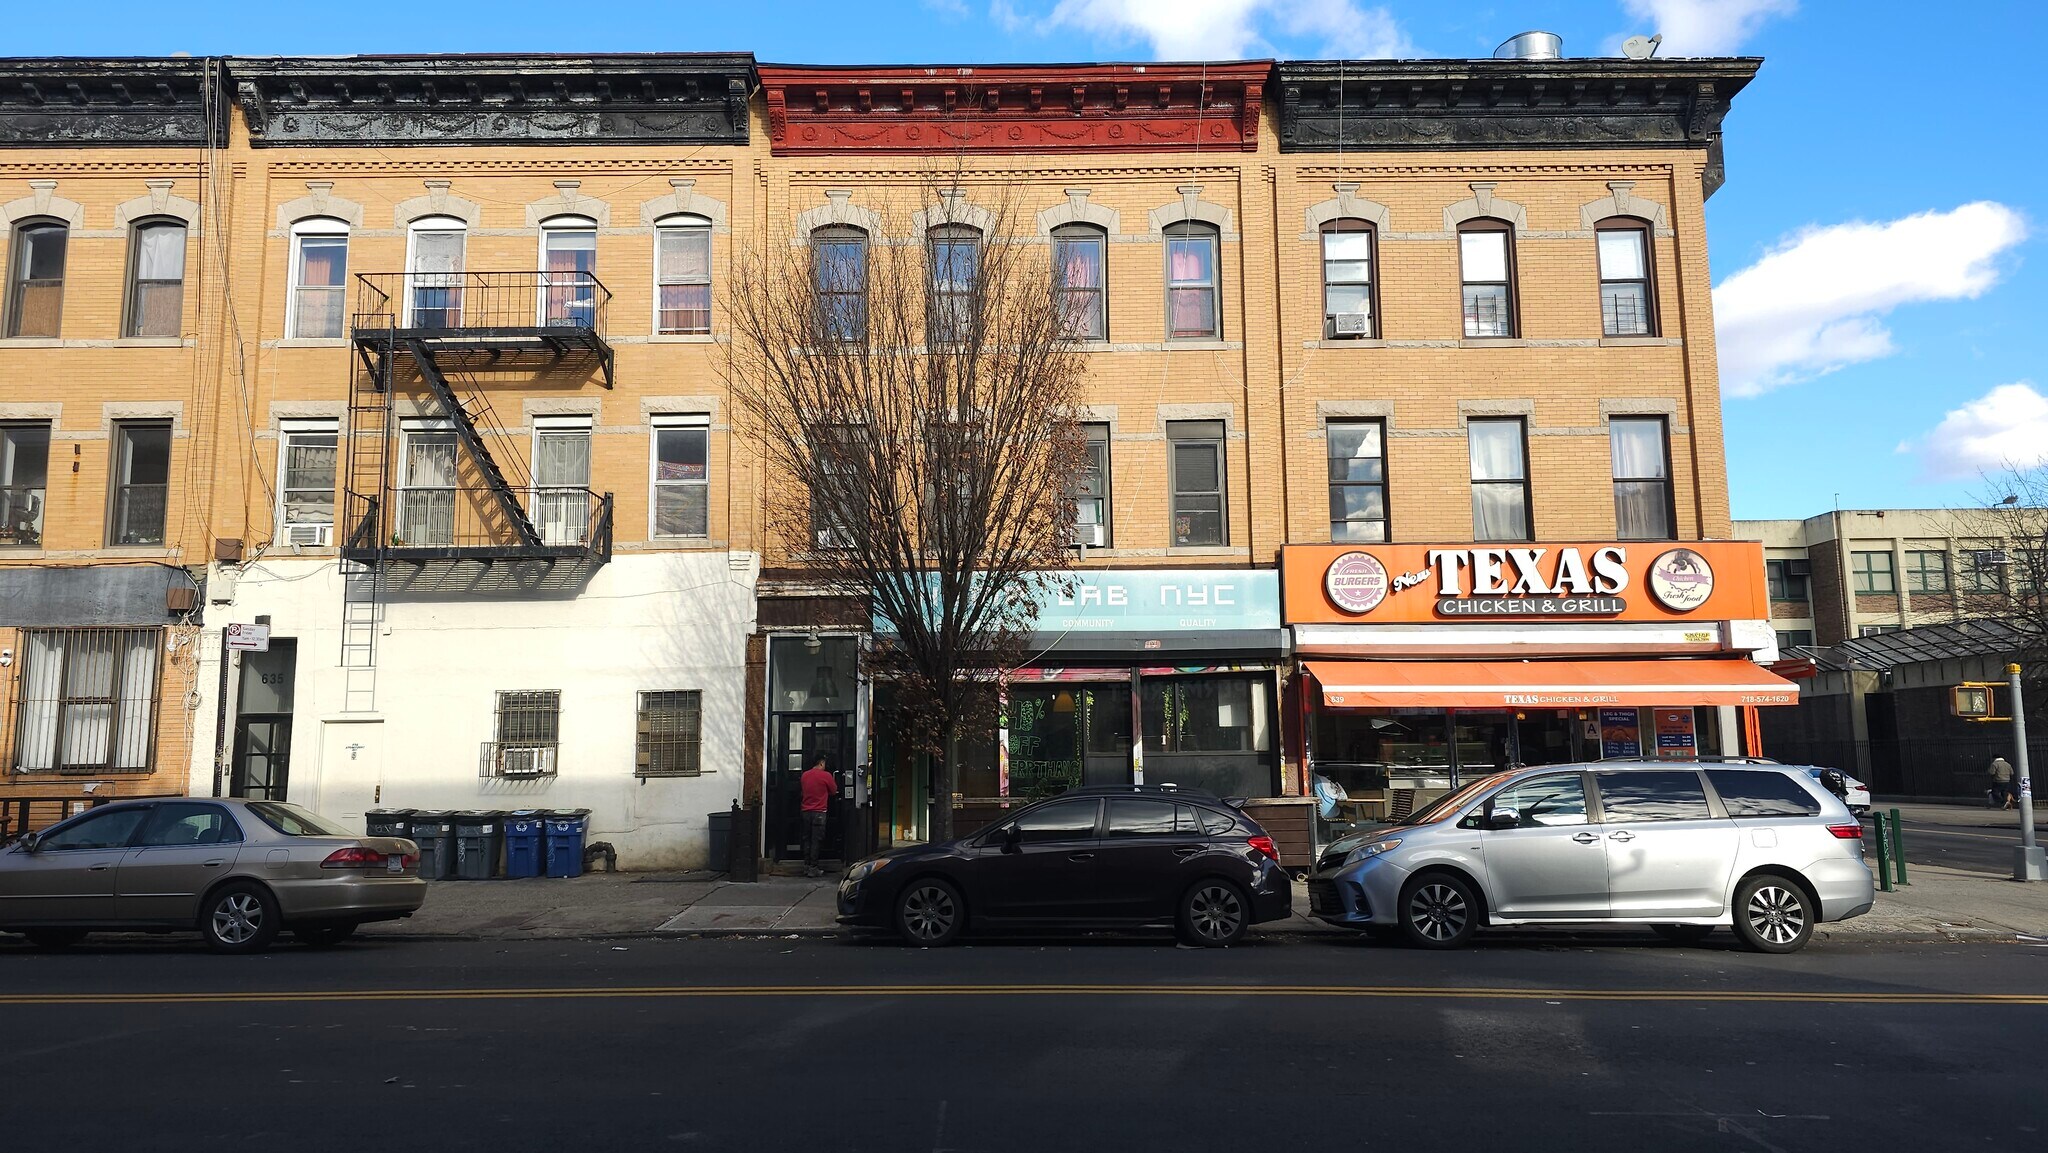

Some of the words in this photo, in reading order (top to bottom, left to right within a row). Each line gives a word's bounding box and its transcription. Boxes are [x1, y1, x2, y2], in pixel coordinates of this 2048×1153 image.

[1393, 569, 1431, 592] New
[1429, 546, 1630, 595] TEXAS
[1334, 577, 1380, 586] BURGERS
[1058, 585, 1128, 606] LAB
[1663, 591, 1684, 599] Fresh
[1680, 594, 1702, 603] food
[1443, 600, 1535, 613] CHICKEN
[1542, 600, 1556, 612] &
[1562, 599, 1623, 612] GRILL
[1062, 619, 1114, 628] COMMUNITY
[1179, 618, 1216, 627] QUALITY
[262, 673, 284, 684] 635
[1504, 694, 1539, 704] TEXAS
[1587, 723, 1597, 734] A
[1009, 735, 1041, 756] OFF
